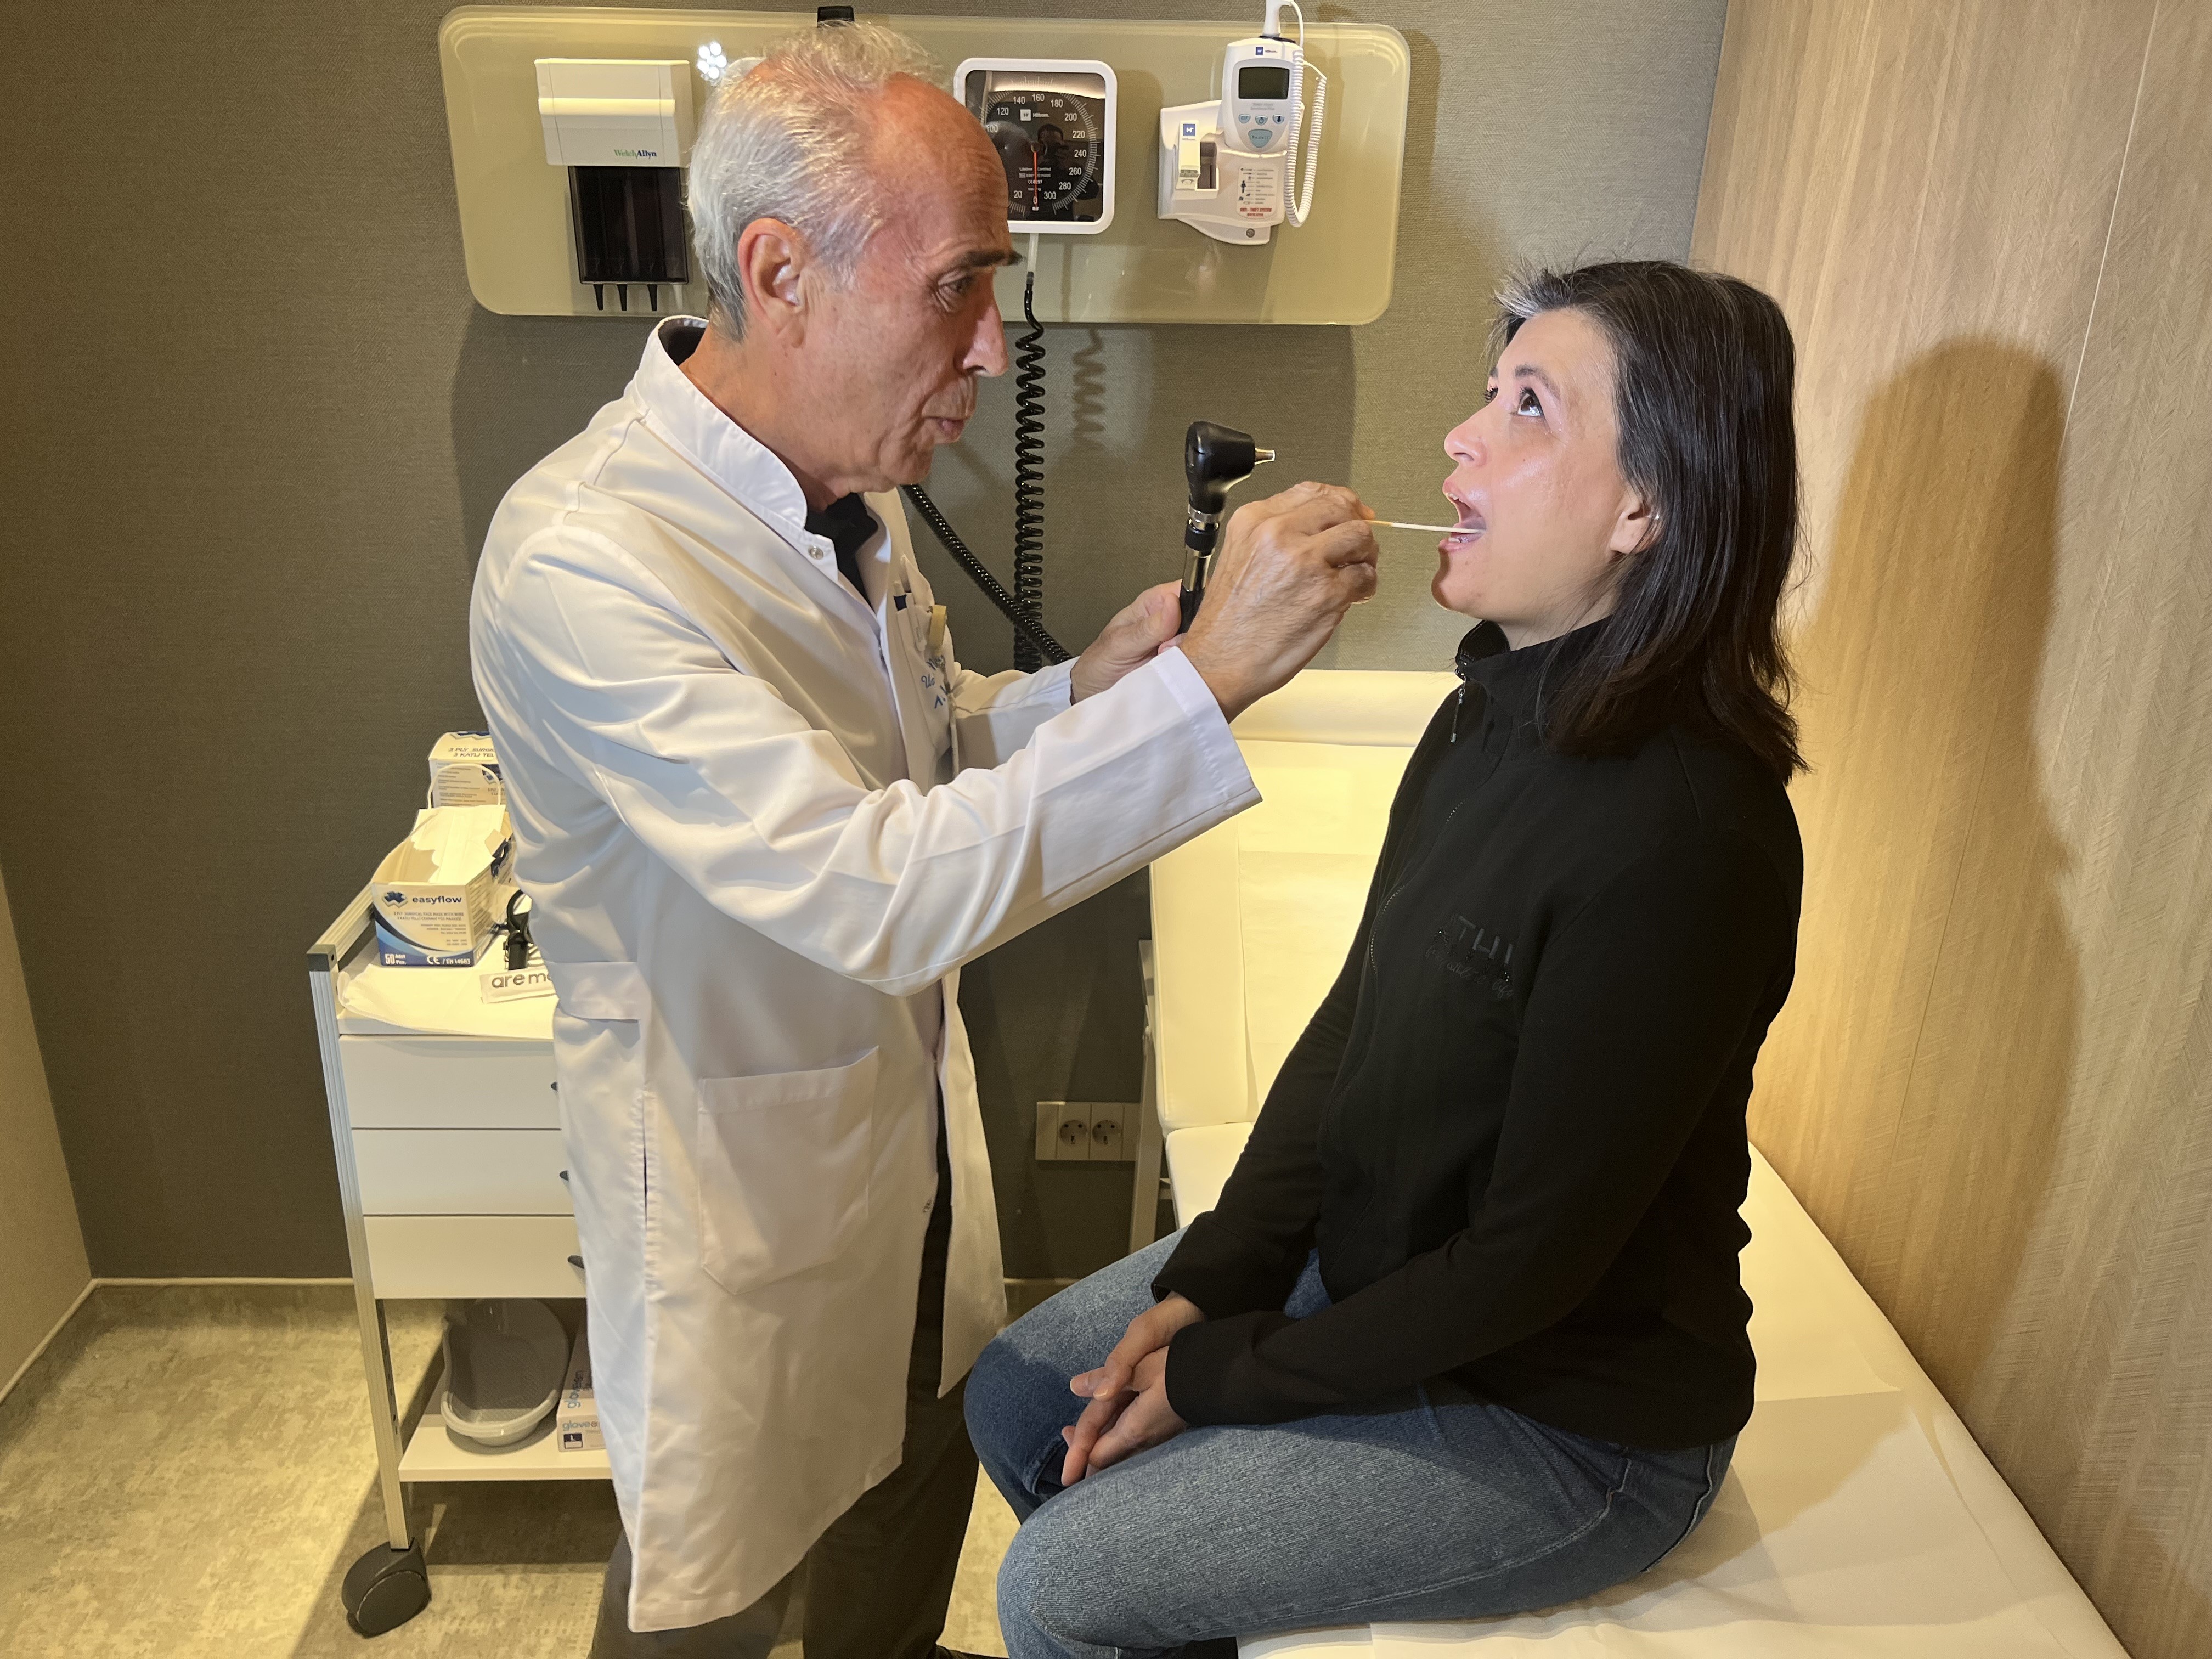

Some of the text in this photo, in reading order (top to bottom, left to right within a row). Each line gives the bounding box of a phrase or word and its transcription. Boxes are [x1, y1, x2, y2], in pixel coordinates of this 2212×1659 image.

[1013, 96, 1025, 104] 140
[1032, 93, 1045, 101] 160
[1051, 99, 1063, 108] 180
[997, 107, 1009, 115] 120
[1064, 113, 1077, 121] 200
[986, 124, 998, 133] 100
[1074, 149, 1087, 157] 240
[1069, 167, 1081, 176] 260
[1059, 182, 1071, 190] 280
[1013, 190, 1023, 199] 20
[1043, 191, 1057, 200] 300
[1033, 196, 1037, 204] 0
[412, 896, 462, 905] easyflow
